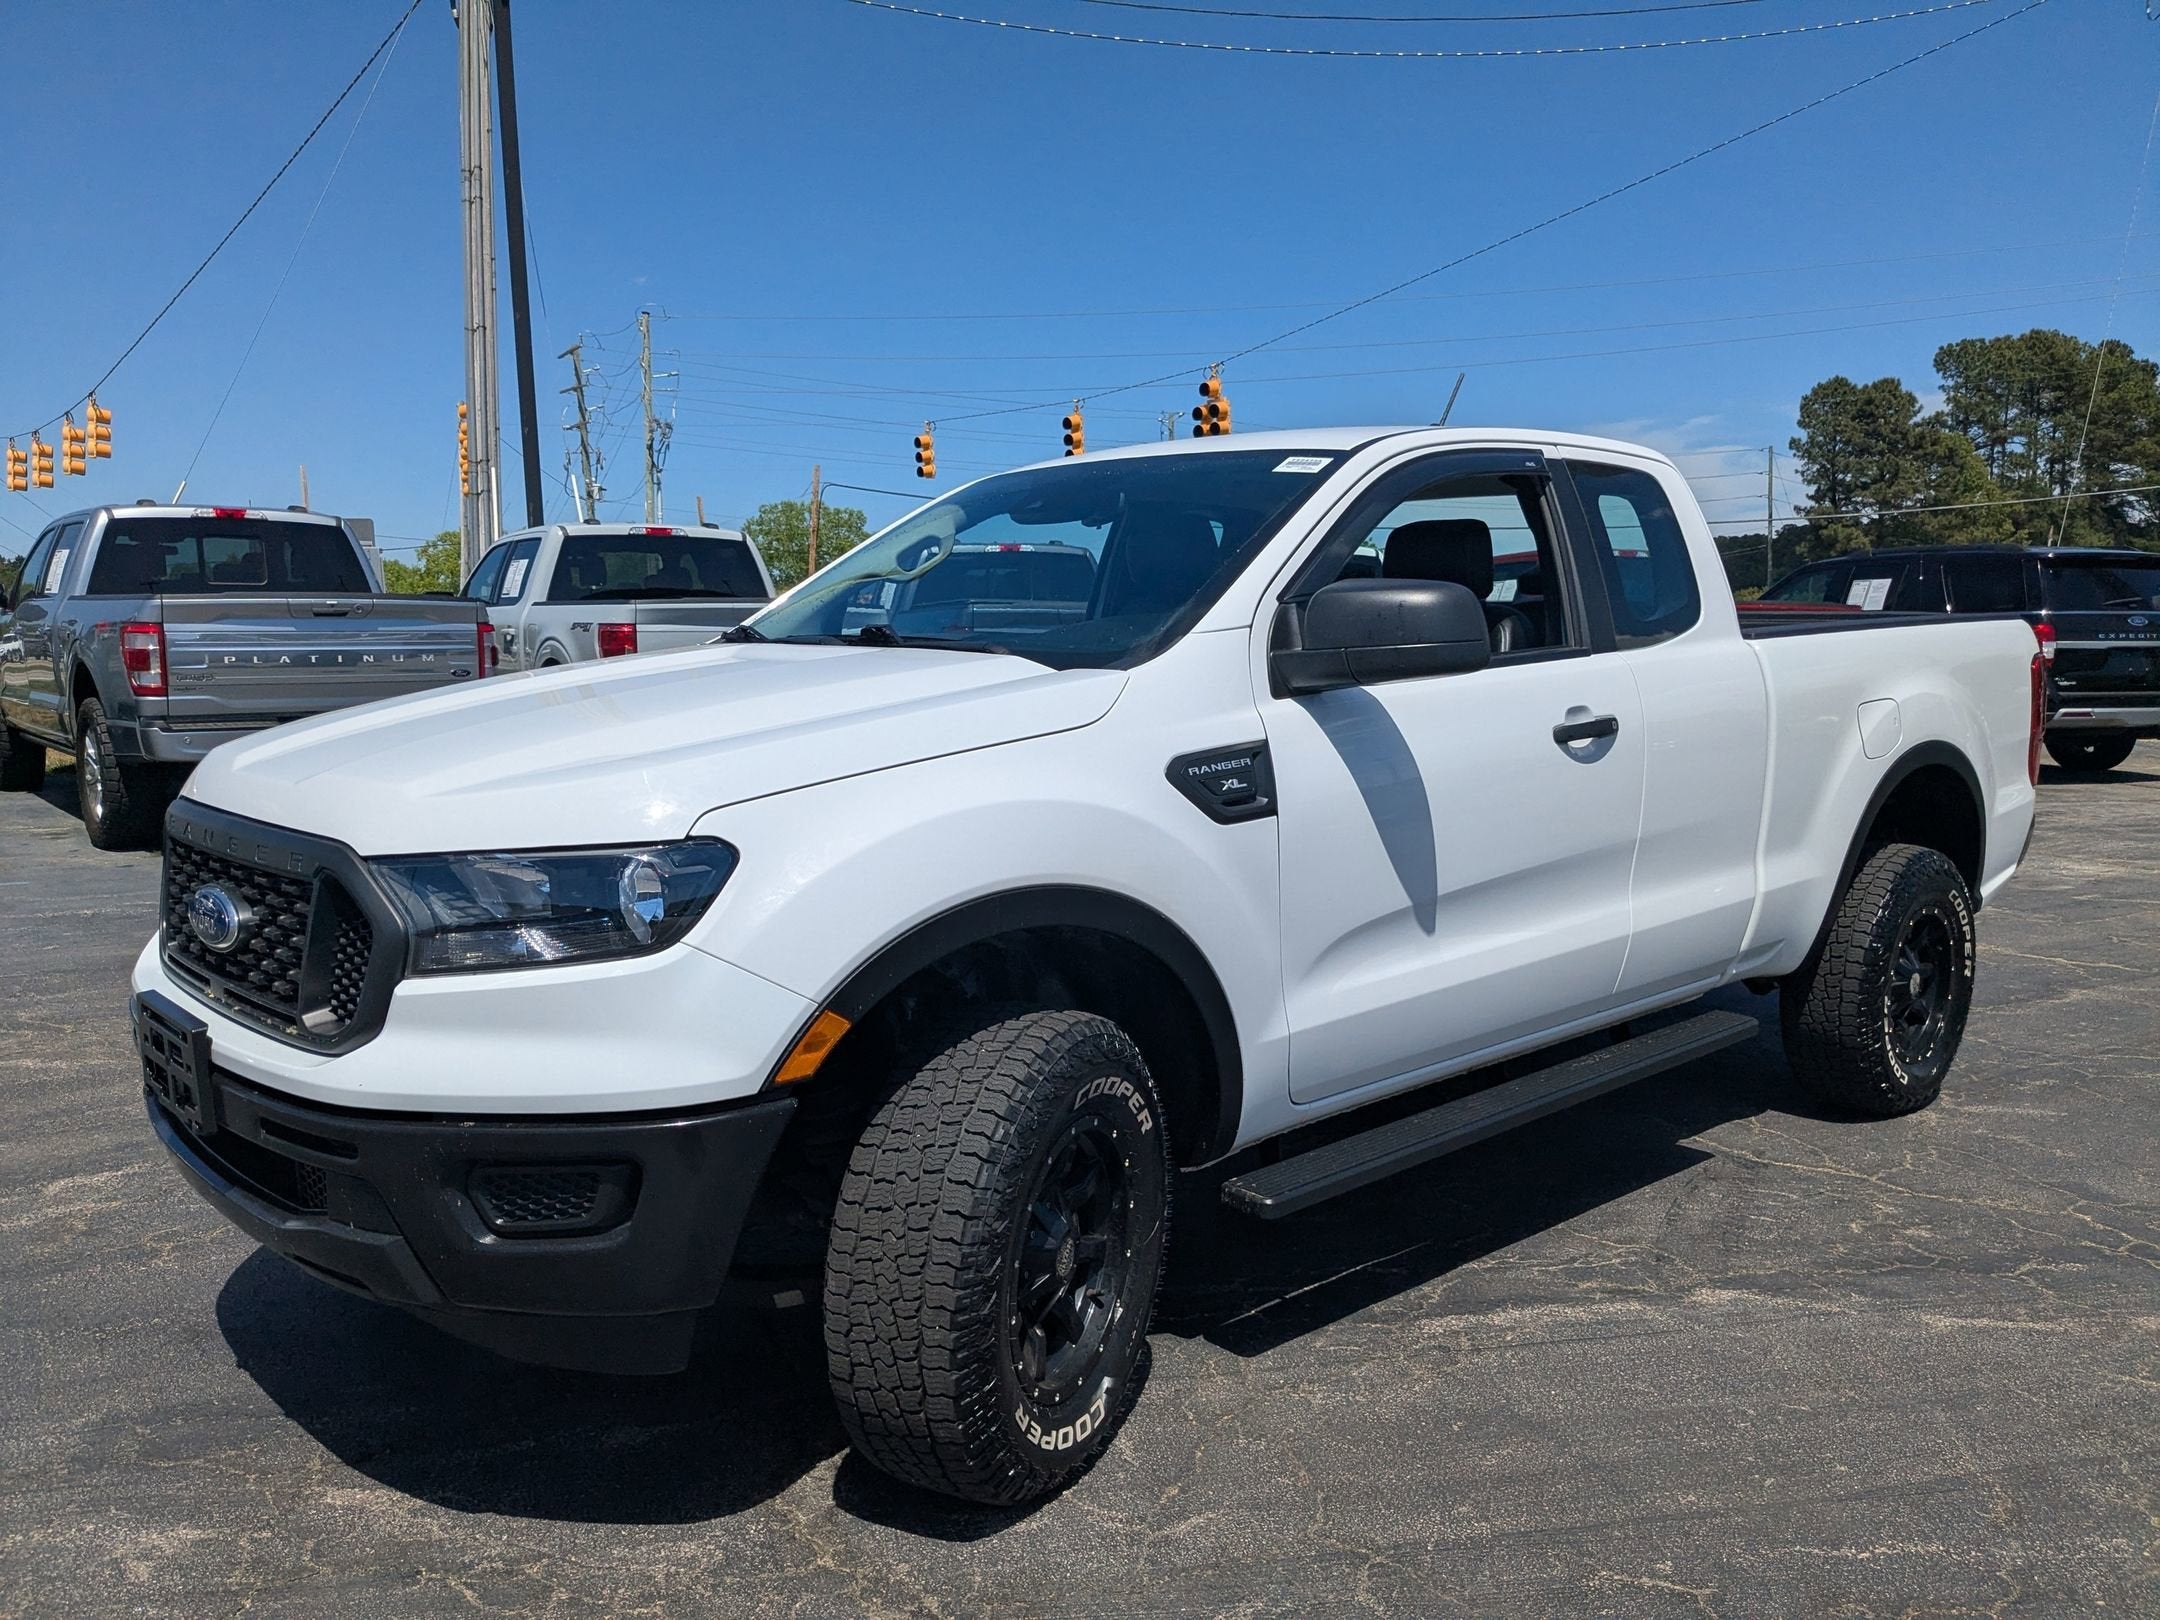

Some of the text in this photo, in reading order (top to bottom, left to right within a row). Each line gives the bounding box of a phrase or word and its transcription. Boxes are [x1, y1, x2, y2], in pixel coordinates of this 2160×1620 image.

[223, 655, 434, 664] PLATINUM
[1188, 758, 1251, 776] RANGER
[1220, 779, 1247, 791] XL
[1948, 889, 1972, 977] COOPER
[1073, 1076, 1153, 1135] COOPER
[1015, 1398, 1105, 1451] COOPER
